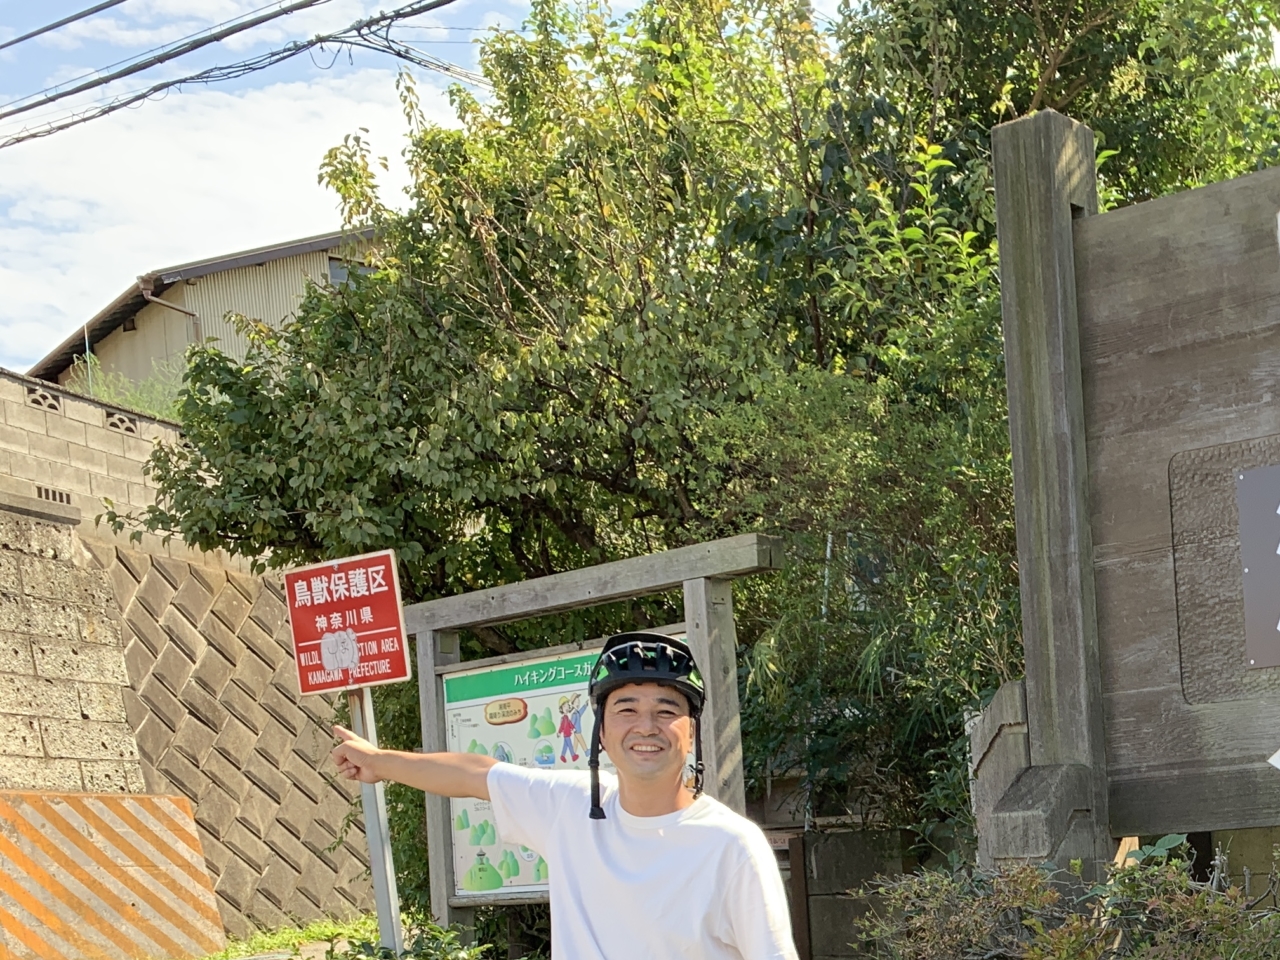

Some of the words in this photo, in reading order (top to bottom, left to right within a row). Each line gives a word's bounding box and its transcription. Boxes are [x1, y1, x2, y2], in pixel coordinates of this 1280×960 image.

[294, 565, 389, 608] 鳥獣保護区
[315, 606, 373, 632] 神奈川県
[300, 651, 321, 667] WILDL
[381, 637, 399, 652] AREA
[307, 667, 343, 685] KANAGAWA
[348, 659, 392, 679] PREFECTURE
[514, 661, 594, 686] ハイキングコースガ
